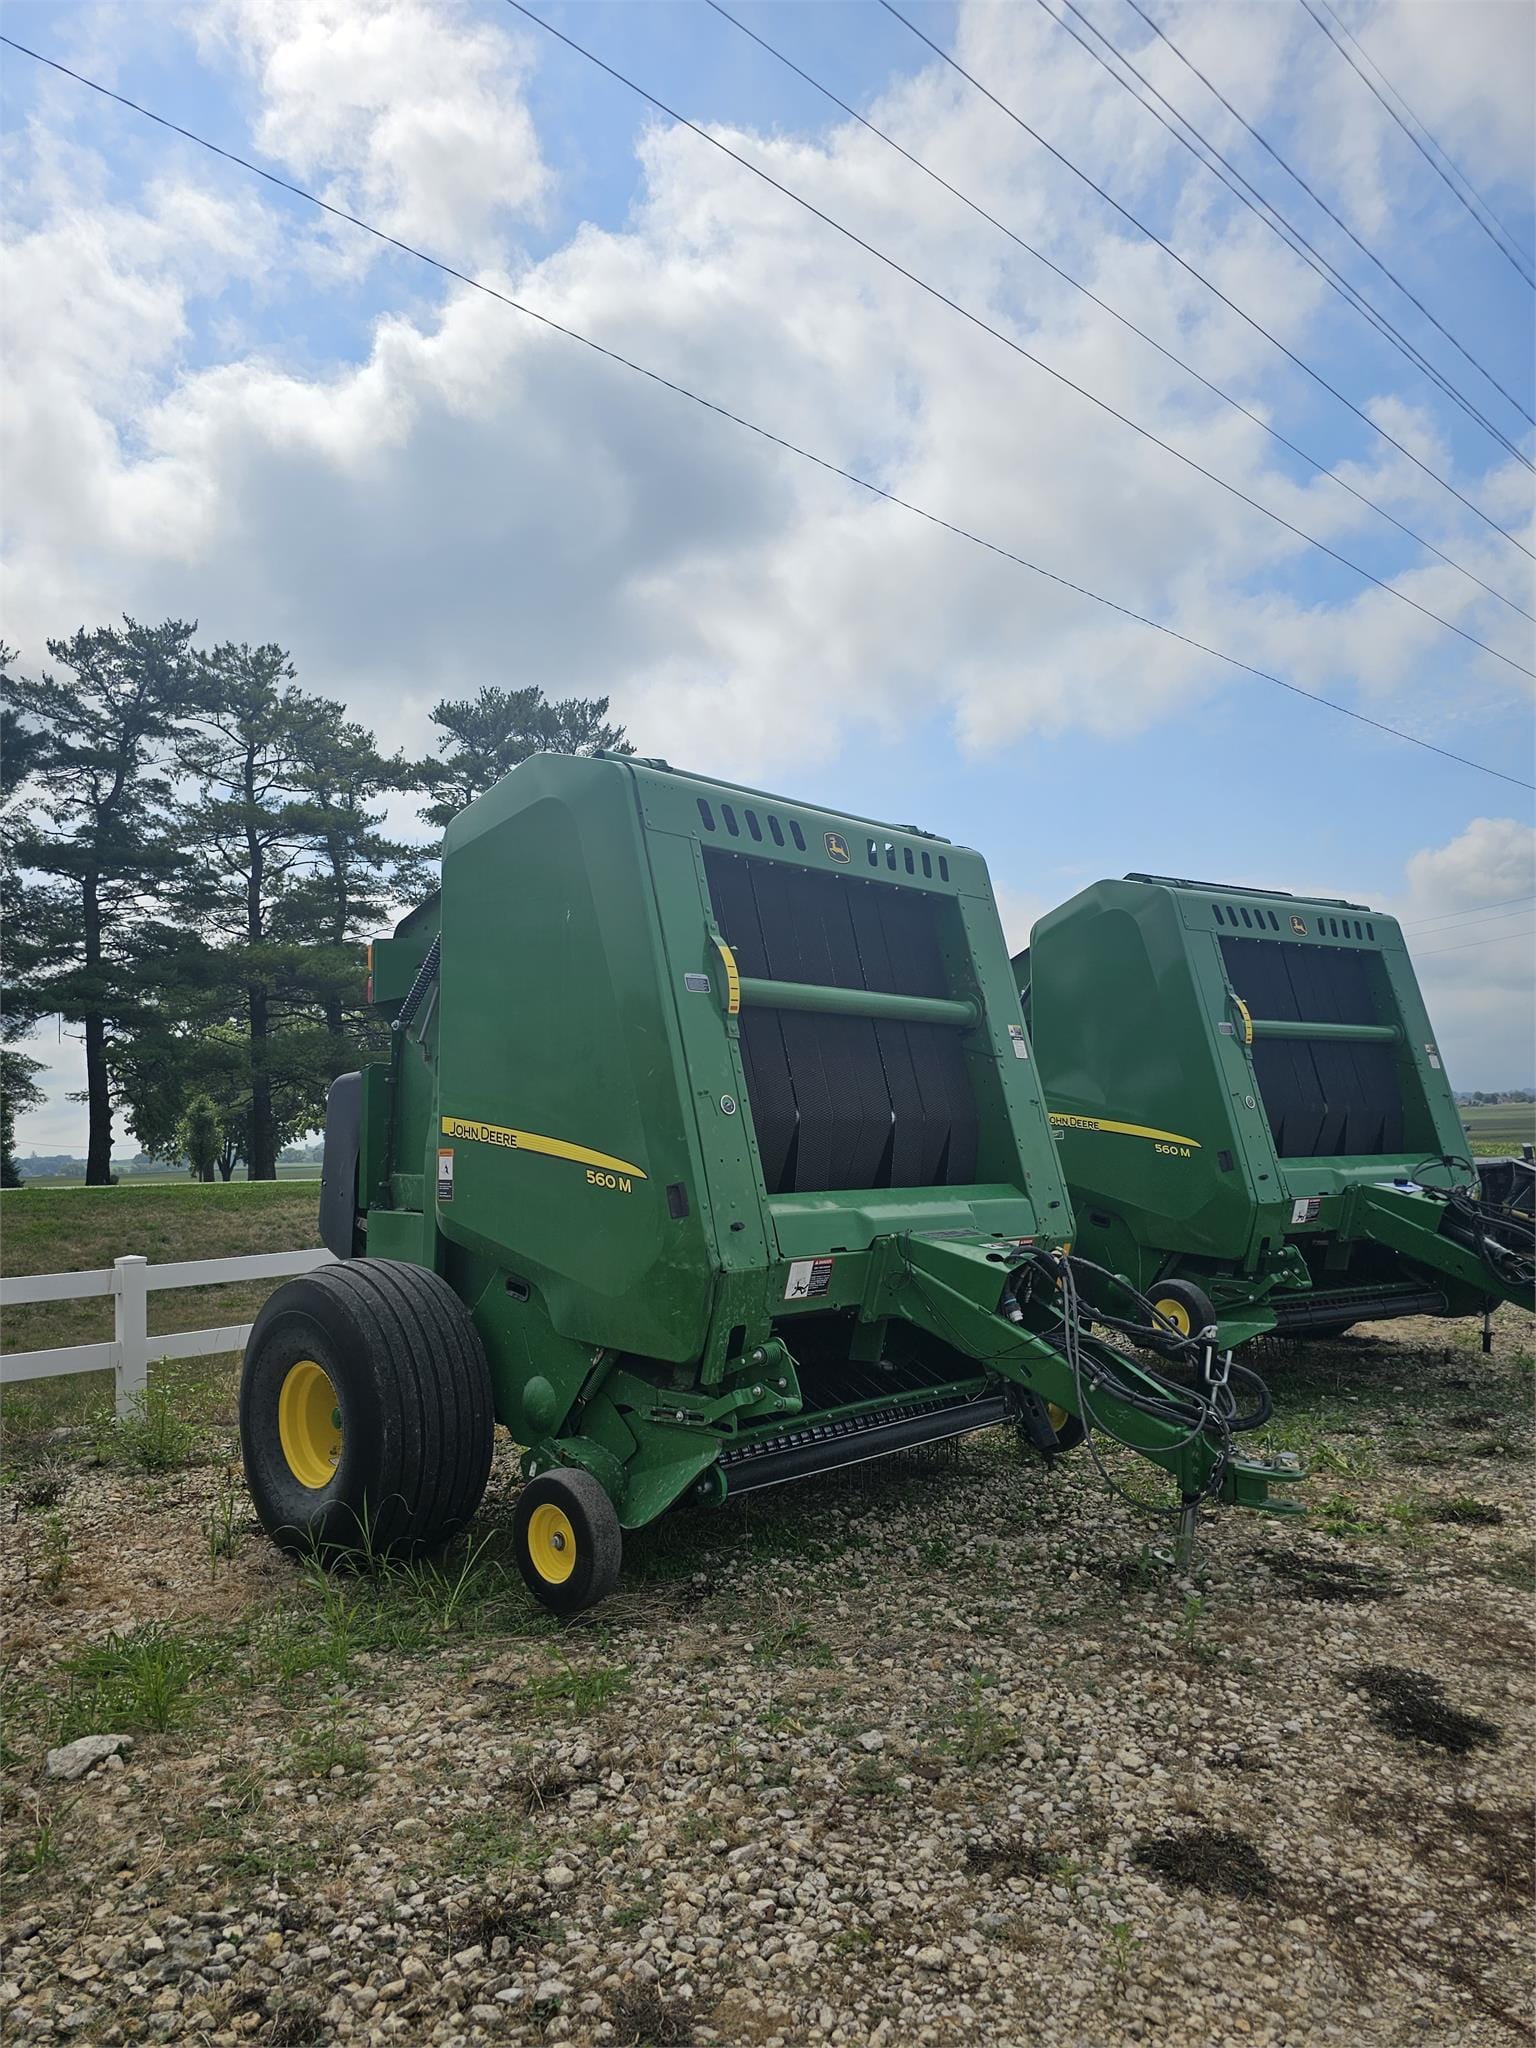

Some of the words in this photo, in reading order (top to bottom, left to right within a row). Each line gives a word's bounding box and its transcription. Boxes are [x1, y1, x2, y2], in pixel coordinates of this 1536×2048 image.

[1049, 1115, 1069, 1125] OHN
[1070, 1117, 1099, 1130] DEERE
[449, 1121, 479, 1140] JOHN
[481, 1126, 517, 1147] DEERE
[1155, 1144, 1178, 1156] 560
[1180, 1148, 1191, 1158] M
[587, 1170, 616, 1189] 560
[619, 1177, 632, 1193] M
